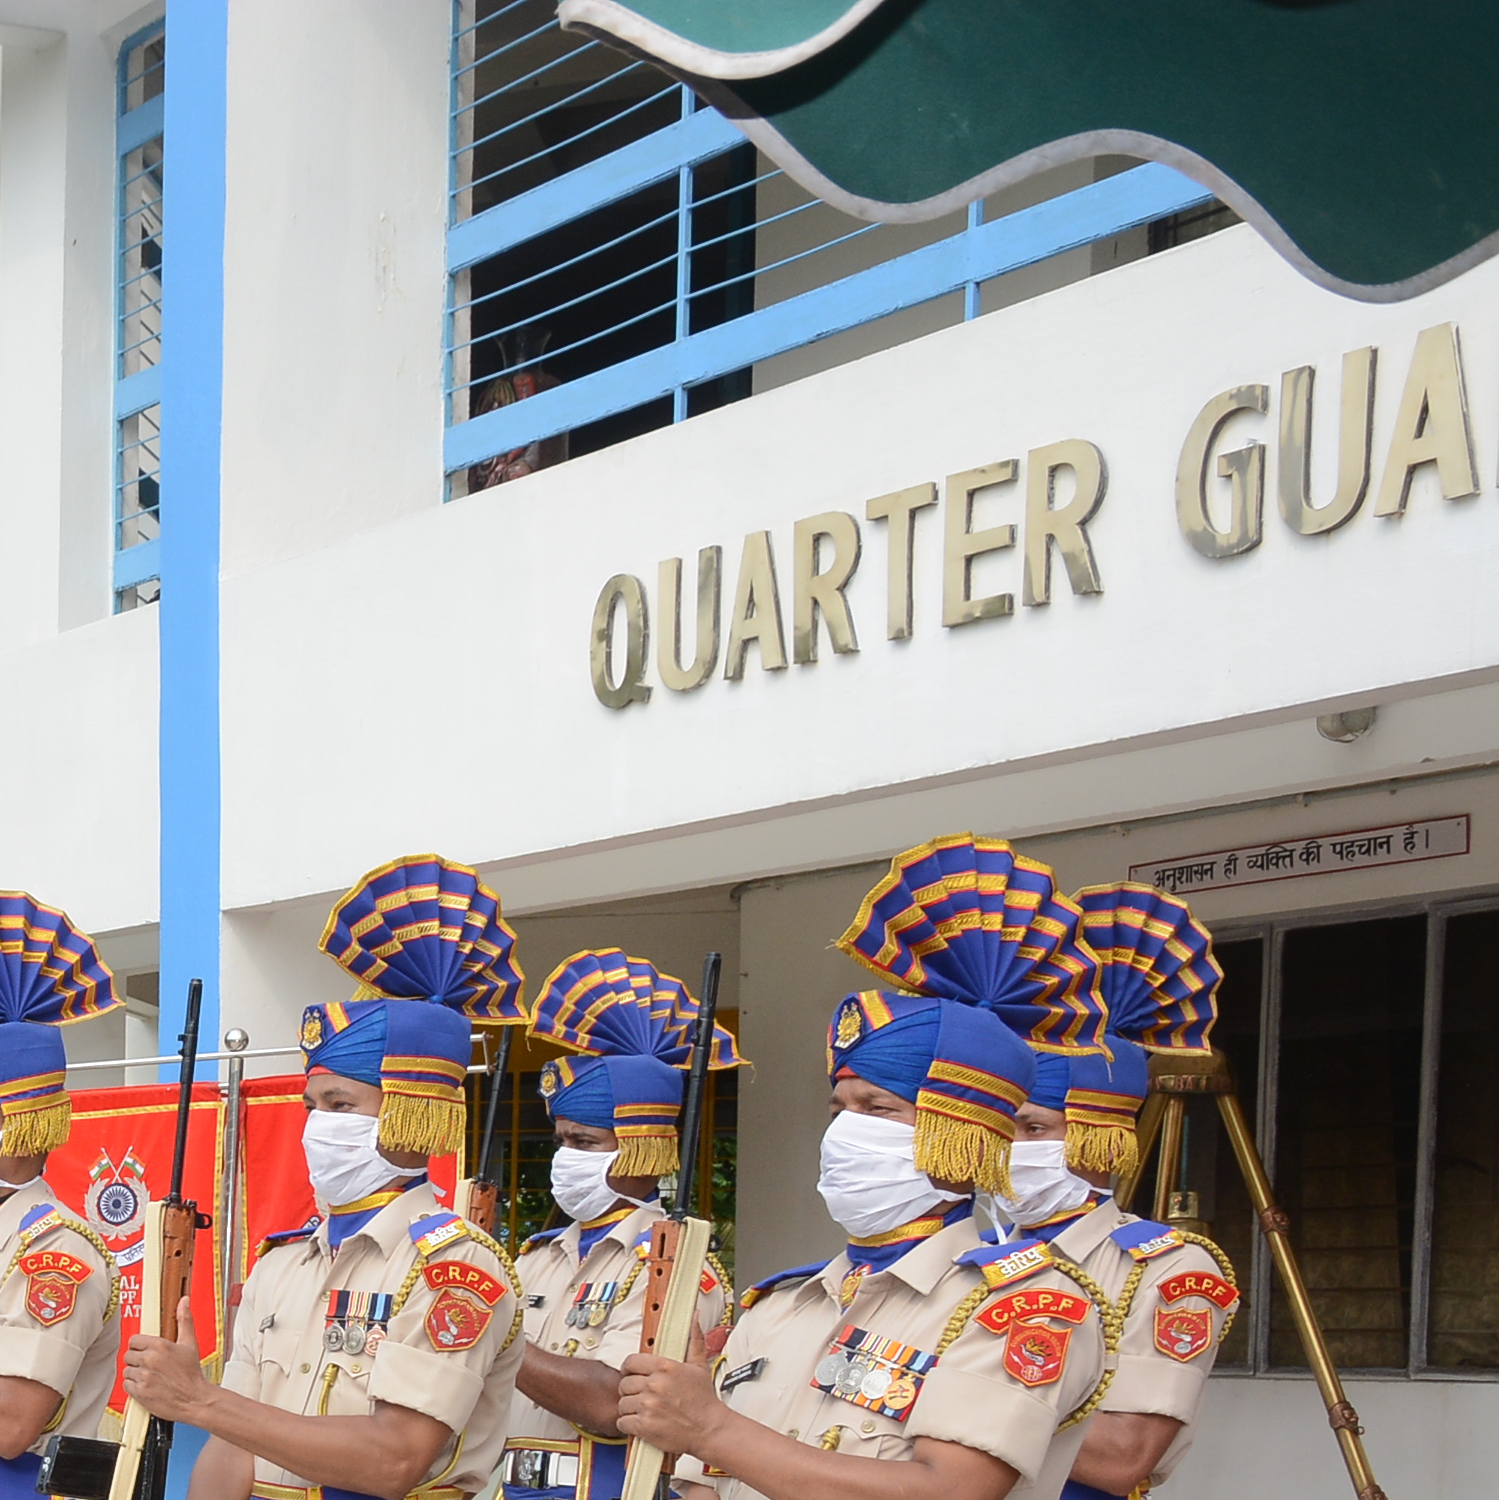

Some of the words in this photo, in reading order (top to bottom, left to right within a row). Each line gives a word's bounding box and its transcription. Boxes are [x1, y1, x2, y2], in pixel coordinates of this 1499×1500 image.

[589, 438, 1108, 710] QUARTER
[1175, 321, 1499, 560] GUA
[1154, 860, 1217, 892] अनुशासन
[1224, 854, 1238, 877] ही
[1247, 844, 1295, 871] व्यक्ति
[1300, 840, 1322, 866] की
[1330, 834, 1393, 861] पहचान
[27, 1254, 83, 1273] C.R.P.F
[431, 1266, 494, 1292] C.R.P.F
[1168, 1276, 1227, 1297] C.R.P.F
[991, 1294, 1074, 1323] C.R.P.F
